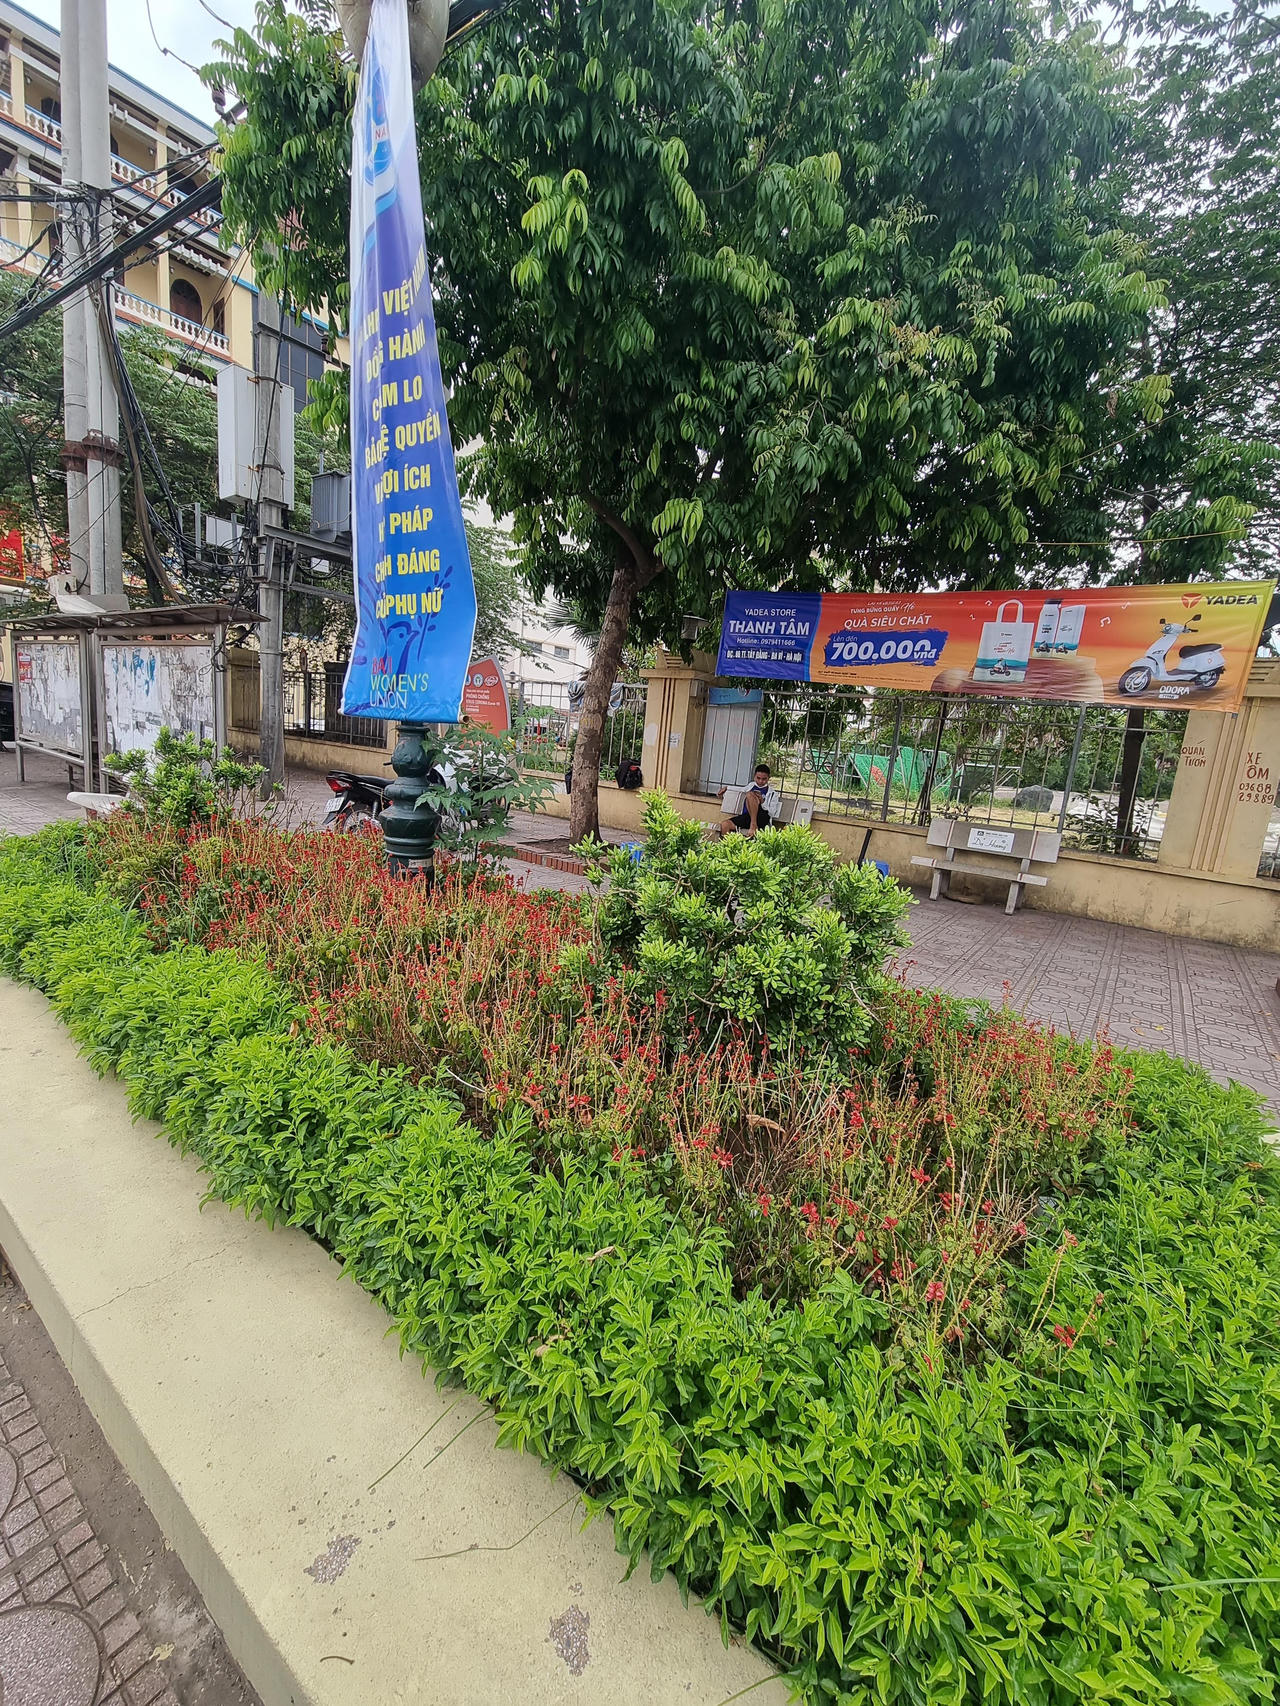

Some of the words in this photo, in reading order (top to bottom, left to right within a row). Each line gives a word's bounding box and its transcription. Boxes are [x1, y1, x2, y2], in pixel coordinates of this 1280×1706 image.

[382, 279, 414, 316] VIỆT
[389, 318, 426, 361] HÀNH
[403, 375, 422, 404] LO
[394, 408, 441, 451] QUYỀN
[404, 464, 431, 491] ÍCH
[390, 505, 434, 534] PHÁP
[397, 547, 440, 576] ĐÁNG
[386, 593, 417, 619] PHỤ
[421, 587, 444, 614] NỮ
[1205, 594, 1258, 606] YADEA
[744, 608, 768, 616] YADEA
[770, 608, 796, 617] STORE
[844, 617, 868, 629] QUÀ
[870, 616, 896, 626] SIÊU
[899, 612, 932, 625] CHẤT
[729, 620, 776, 634] THANH
[780, 618, 810, 636] TÂM
[830, 640, 932, 660] 700.000
[370, 690, 407, 710] UNION
[1160, 685, 1190, 695] ODORA
[1247, 752, 1262, 764] XE
[1247, 764, 1269, 780] ÔM
[1239, 782, 1272, 794] 03688
[1239, 792, 1274, 804] 29889
